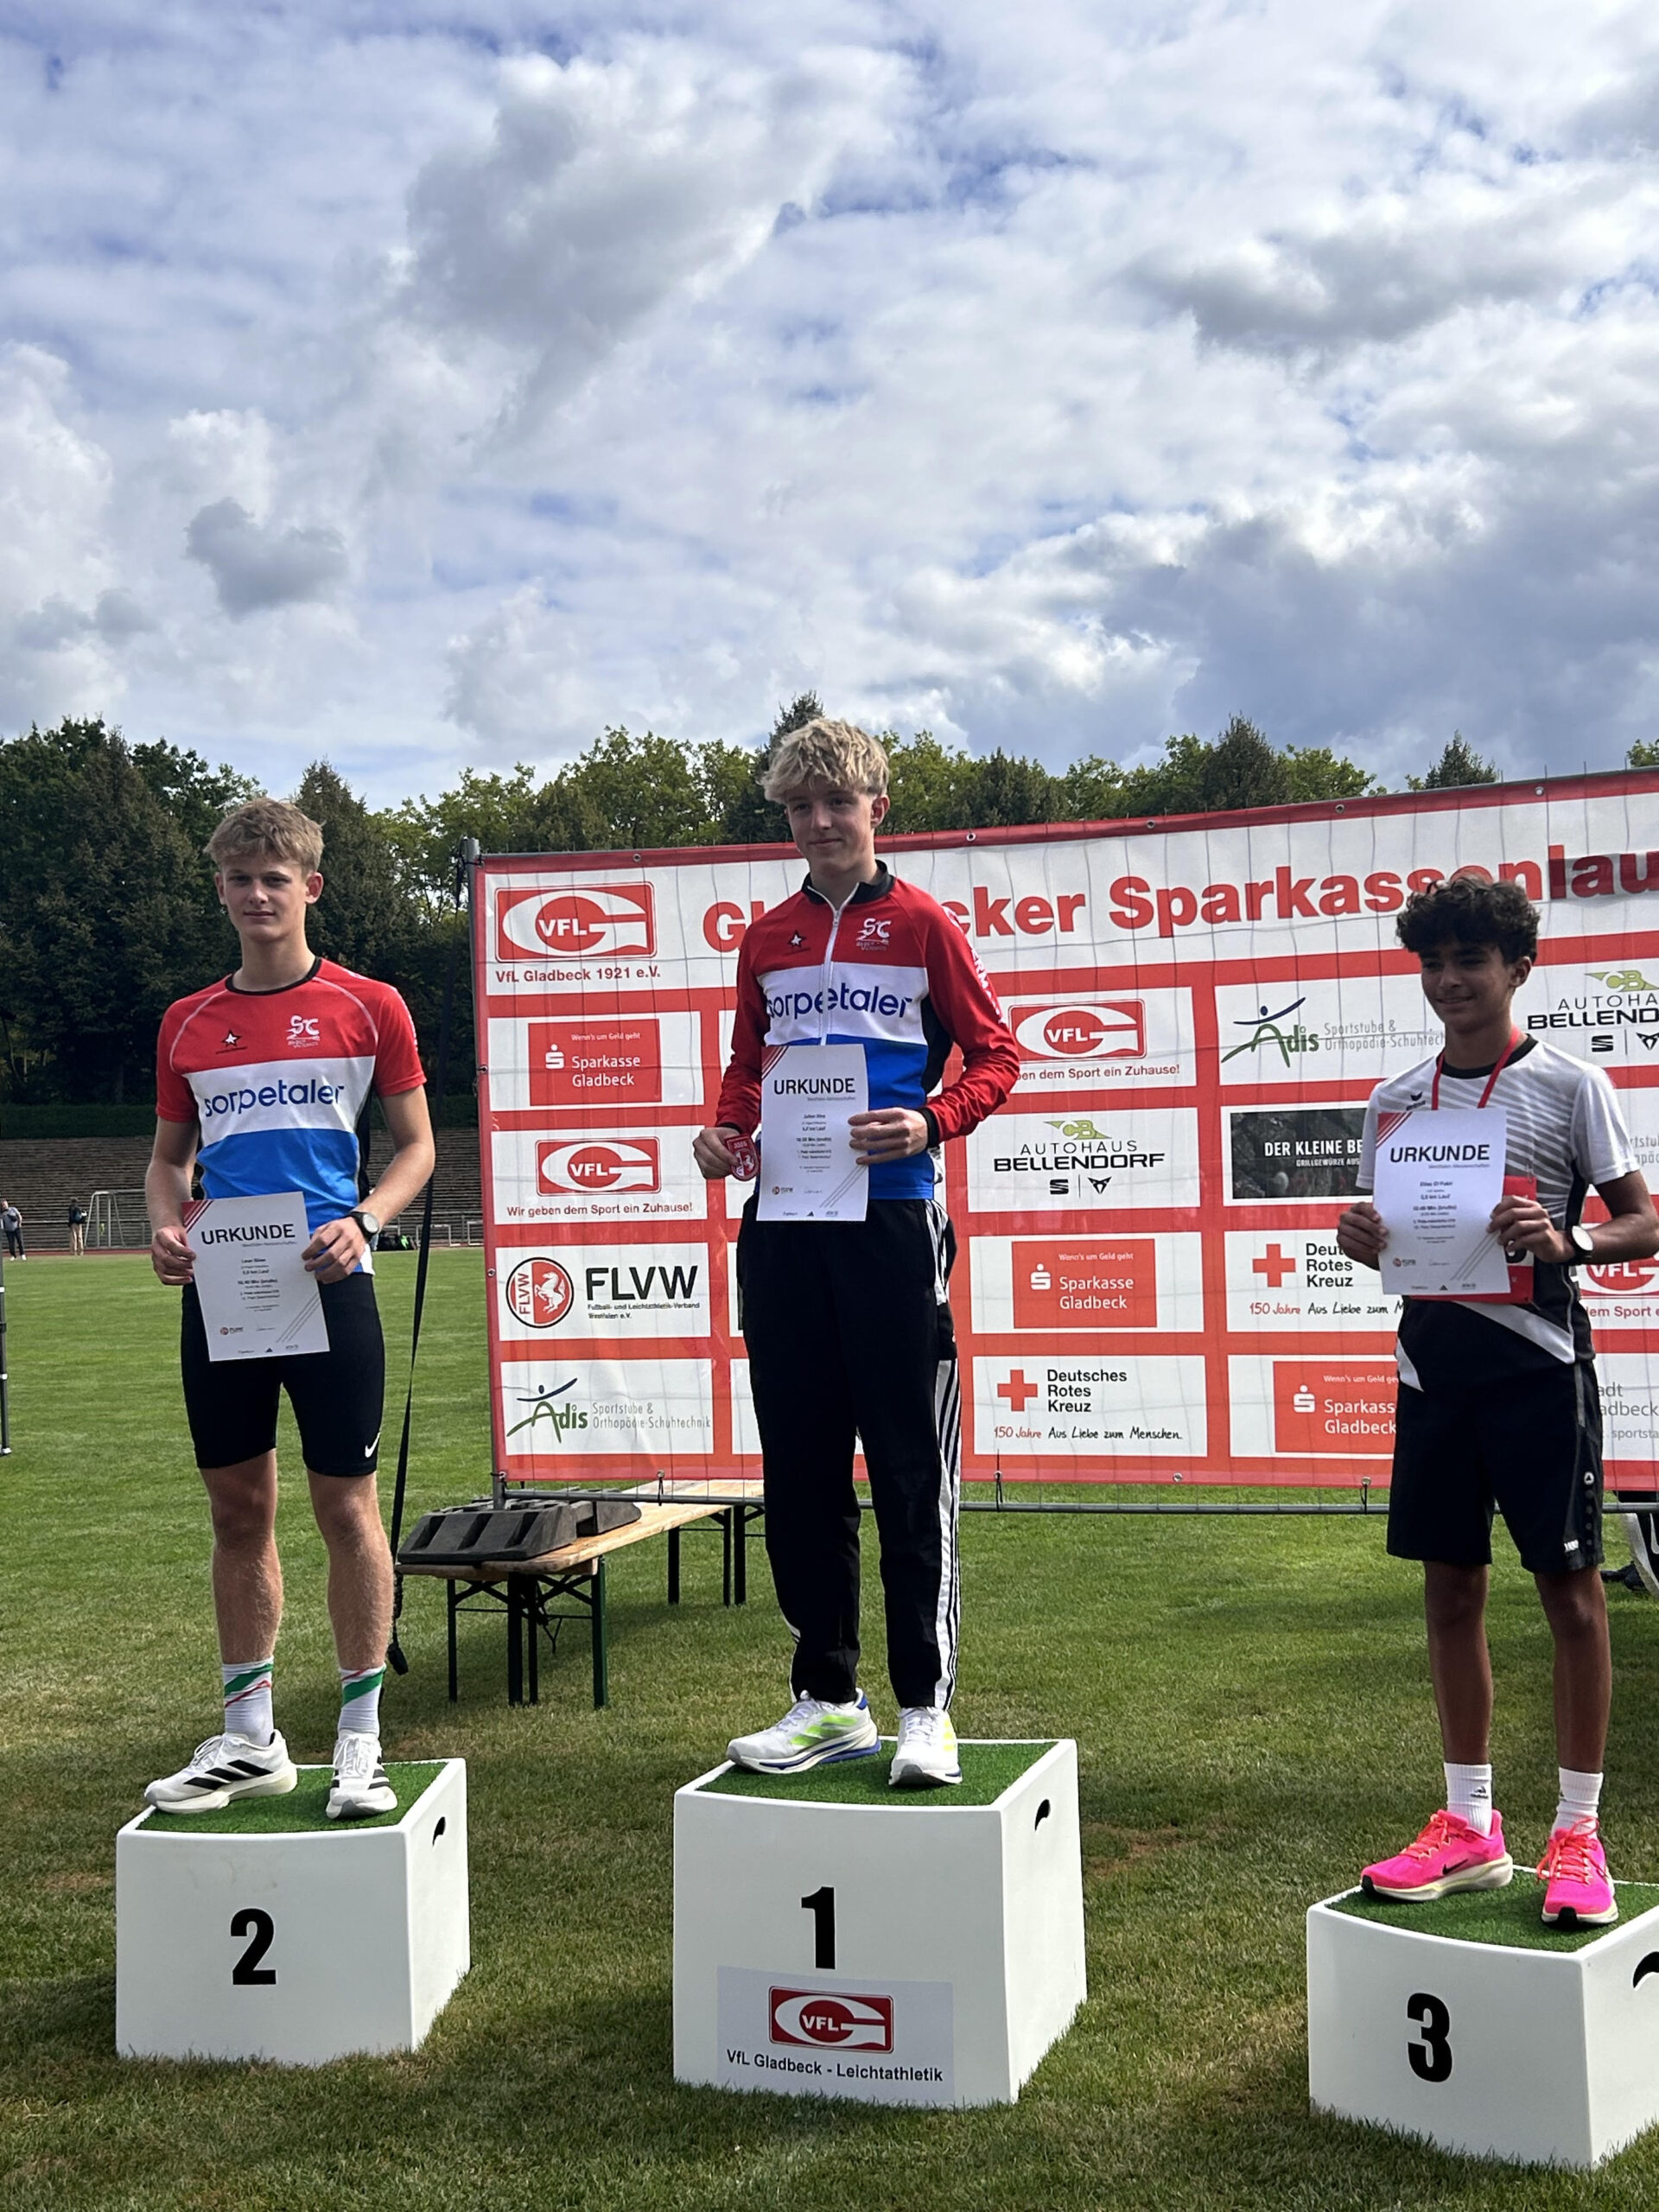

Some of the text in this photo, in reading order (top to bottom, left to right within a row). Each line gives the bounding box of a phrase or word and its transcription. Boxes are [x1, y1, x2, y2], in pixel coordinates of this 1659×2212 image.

[538, 918, 588, 937] VFL
[496, 965, 661, 983] VfL Gladbeck 1921 e.V.
[766, 982, 913, 1020] sorpetaler
[1557, 993, 1659, 1011] AUTOHA
[1527, 1007, 1659, 1030] BELLEND
[1046, 1027, 1089, 1043] VFL
[1324, 1020, 1396, 1037] Sportstube &
[608, 1032, 624, 1040] Geld
[625, 1032, 640, 1042] geht
[571, 1055, 641, 1072] Sparkasse
[1039, 1068, 1065, 1080] dem
[1068, 1066, 1101, 1080] Sport
[1103, 1066, 1122, 1077] ein
[1125, 1064, 1180, 1076] Zuhause!
[571, 1074, 635, 1088] Gladbeck
[773, 1077, 855, 1095] URKUNDE
[205, 1078, 345, 1118] sorpetaler
[1020, 1140, 1137, 1156] AUTOHAUS
[1264, 1141, 1291, 1156] DER
[1295, 1139, 1343, 1155] KLEINE
[1389, 1144, 1491, 1163] URKUNDE
[569, 1162, 608, 1177] VFL
[994, 1153, 1166, 1172] BELLENDORF
[506, 1202, 693, 1217] Wir geben dem Sport ein Zuhause!
[201, 1224, 296, 1245] URKUNDE
[1058, 1253, 1084, 1262] Wenn's
[1098, 1252, 1116, 1261] Geld
[1116, 1252, 1134, 1262] geht
[1306, 1258, 1353, 1272] Rotes
[1590, 1262, 1637, 1278] VFL
[585, 1265, 698, 1301] FLVW
[1059, 1276, 1135, 1292] Sparkasse
[1306, 1274, 1354, 1287] Kreuz
[518, 1272, 531, 1315] FLVW
[1059, 1295, 1128, 1309] Gladbeck
[1249, 1302, 1270, 1315] 150
[1272, 1301, 1301, 1315] Jahre
[1307, 1302, 1328, 1315] Aus
[1332, 1301, 1361, 1315] Liebe
[1367, 1306, 1389, 1315] zum
[1613, 1306, 1652, 1319] Sport
[1047, 1369, 1128, 1382] Deutsches
[1386, 1375, 1398, 1384] ge
[1047, 1383, 1091, 1397] Rotes
[593, 1402, 654, 1416] Sportstube &
[1047, 1399, 1092, 1413] Kreuz
[1324, 1399, 1395, 1416] Sparkass
[593, 1415, 711, 1431] Orthopädie-Schuhtechnik
[1324, 1419, 1396, 1434] Gladbeck
[994, 1426, 1184, 1440] 150 Jahre Aus Liebe zum Menschen.
[801, 1886, 836, 1969] 1
[230, 1908, 276, 1985] 2
[802, 2014, 839, 2032] VFL
[1407, 1993, 1453, 2082] 3
[727, 2049, 750, 2066] VfL
[753, 2053, 822, 2075] Gladbeck
[836, 2063, 944, 2082] Leichtathletik
